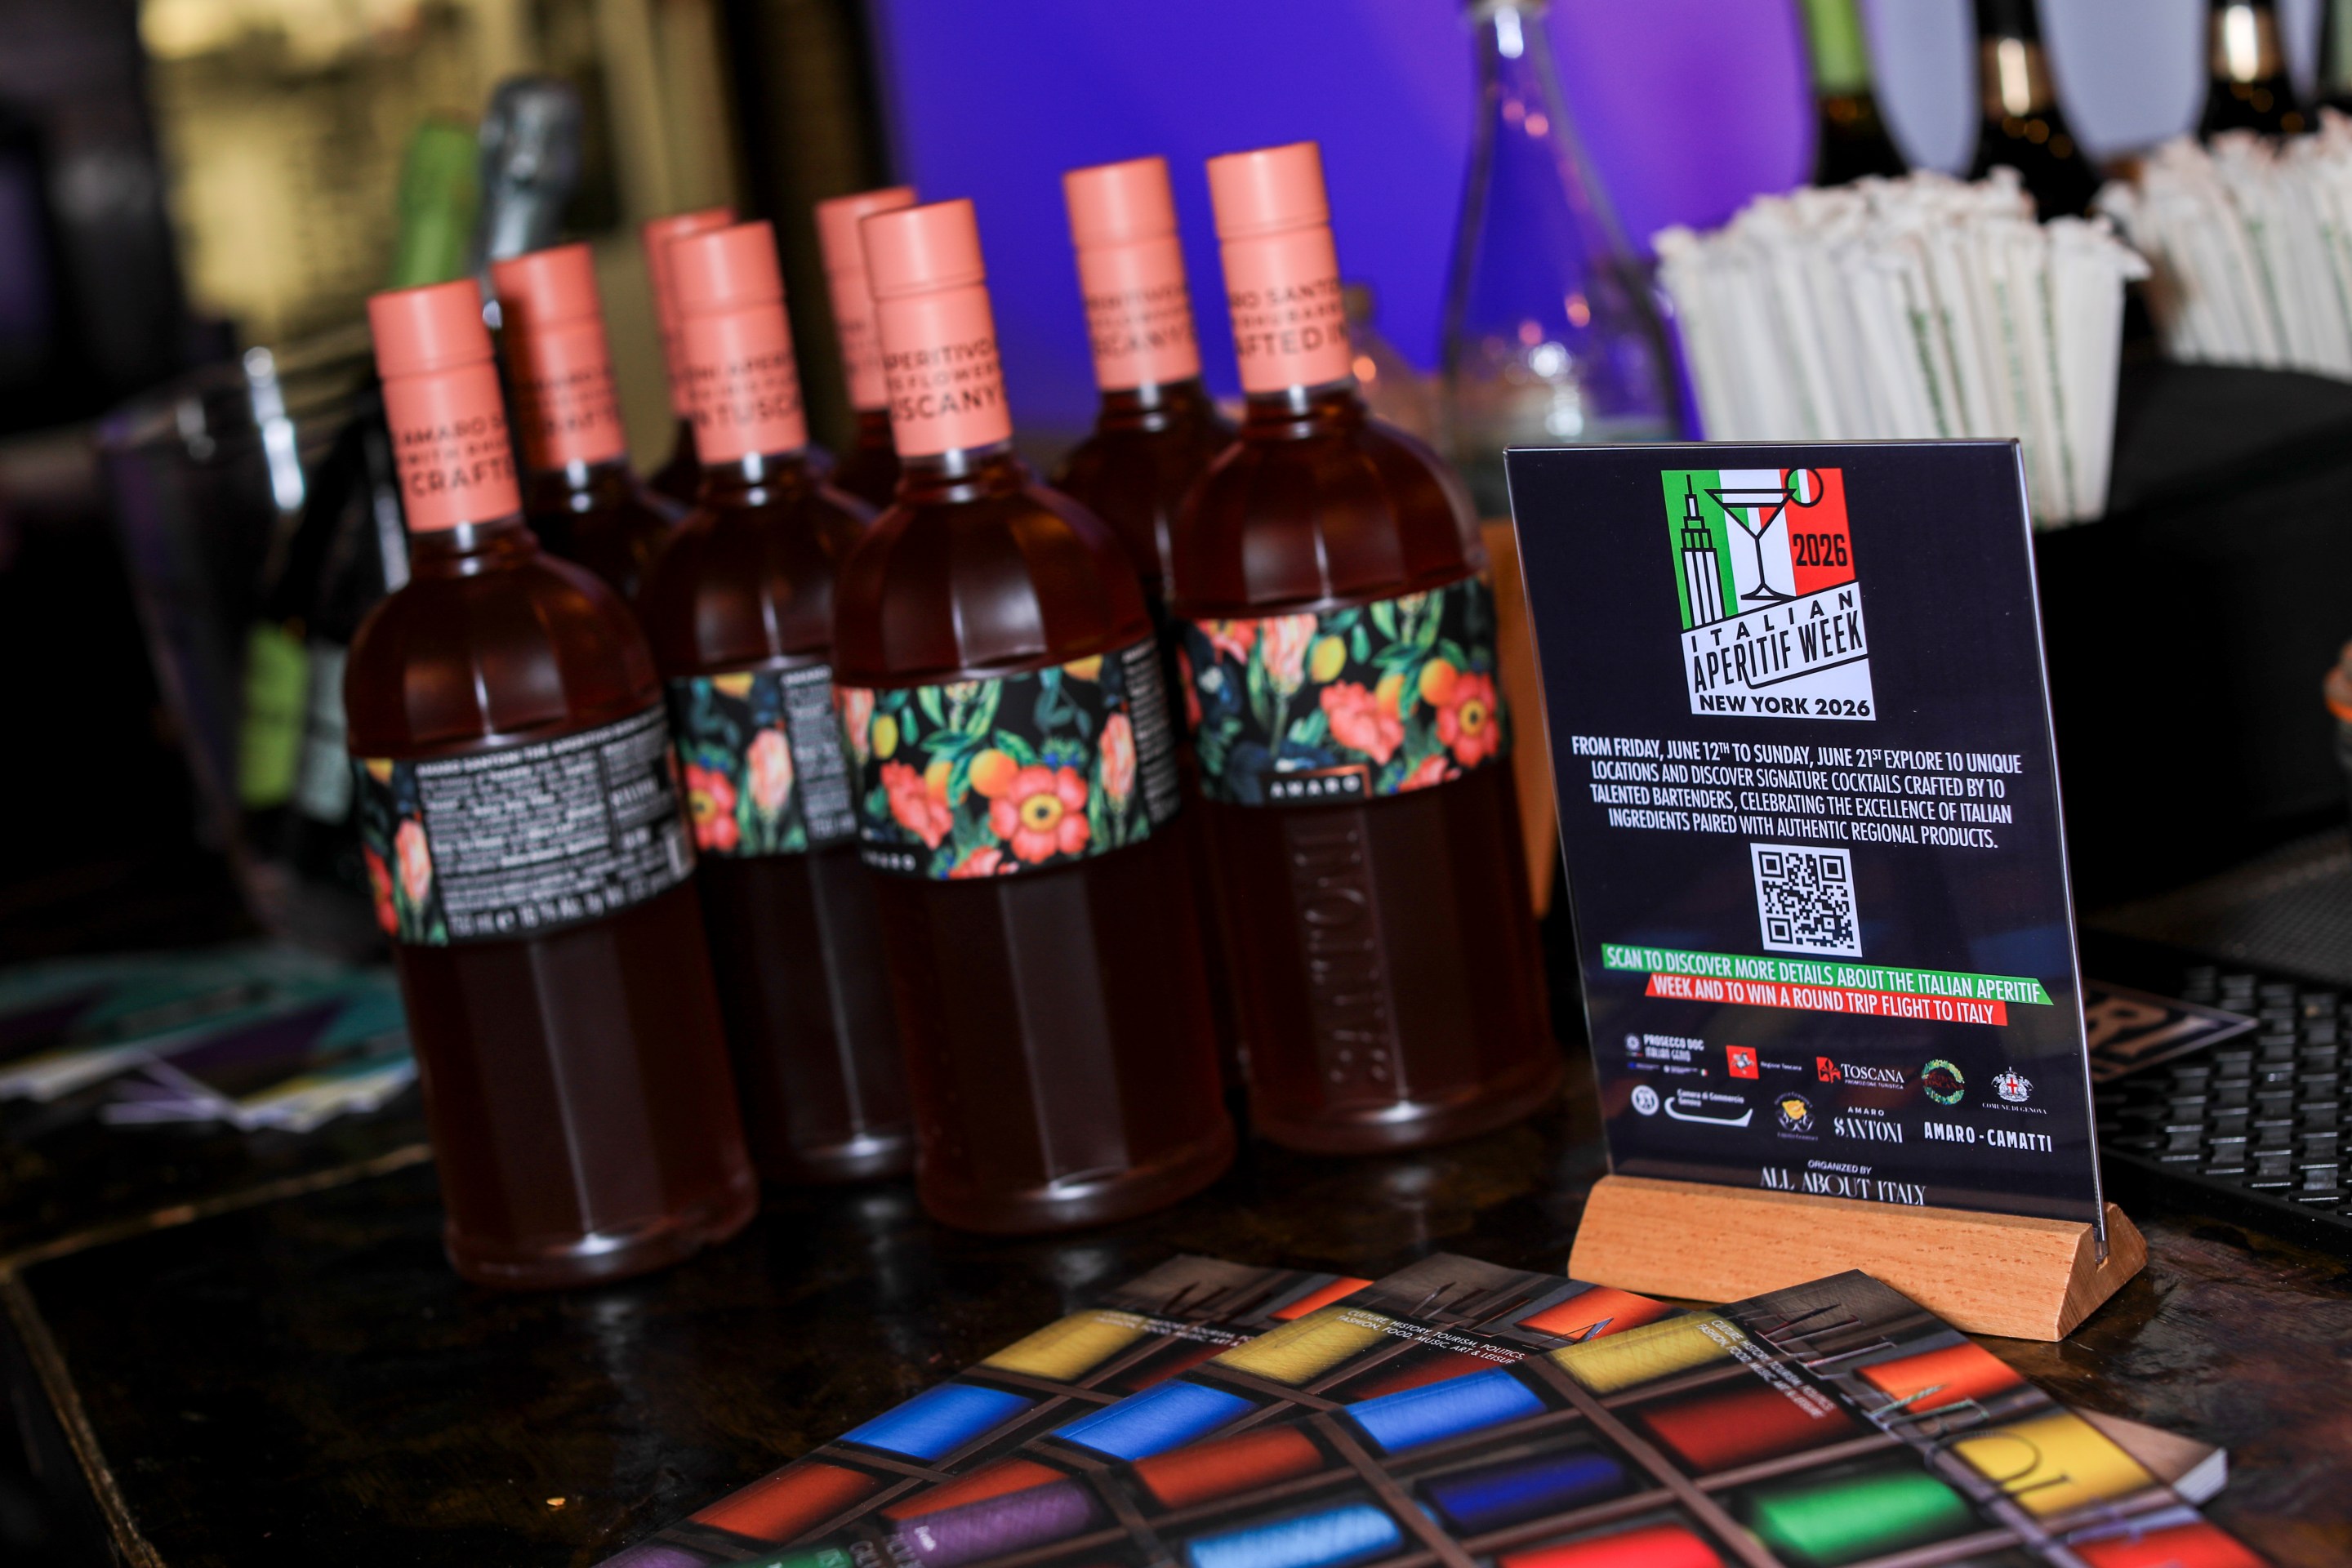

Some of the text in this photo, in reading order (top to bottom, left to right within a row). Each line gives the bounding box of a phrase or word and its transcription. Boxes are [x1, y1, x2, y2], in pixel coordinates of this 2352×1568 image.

[1794, 533, 1847, 567] 2026
[1691, 590, 1853, 654] ITALIAN
[1694, 610, 1864, 693] APERITIF WEEK
[1699, 694, 1870, 717] NEW YORK 2026
[1571, 736, 2023, 774] FROM FRIDAY, JUNE 12TH TO SUNDAY, JUNE 21ST EXPLORE 10 UNIQUE
[1591, 760, 2005, 799] LOCATIONS AND DISCOVER SIGNATURE COCKTAILS CRAFTED BY 10
[1590, 783, 2013, 824] TALENTED BARTENDERS, CELEBRATING THE EXCELLENCE OF ITALIAN
[1608, 808, 1998, 849] INGREDIENTS PAIRED WITH AUTHENTIC REGIONAL PRODUCTS.
[1606, 947, 2041, 1003] SCAN TO DISCOVER MORE DETAILS ABOUT THE ITALIAN APERITIF
[1652, 974, 1993, 1024] WEEK AND TO WIN A ROUND TRIP FLIGHT TO ITALY
[1643, 1034, 1705, 1051] PROSECCO DOC
[1841, 1063, 1904, 1083] TOSCANA
[1848, 1107, 1884, 1116] AMARO
[1982, 1102, 2010, 1111] COMUNE
[2020, 1107, 2047, 1115] GENOVA
[1833, 1116, 1903, 1143] SANTONI
[1924, 1121, 1975, 1143] AMARO
[1987, 1129, 2052, 1152] CAMATTI
[1760, 1166, 1927, 1205] ALL ABOUT ITALY
[1807, 1160, 1872, 1175] ORGANIZED BY
[1337, 1315, 1380, 1331] FASHION,
[1382, 1326, 1413, 1339] FOOD,
[1414, 1335, 1450, 1349] MUSIC,
[1450, 1345, 1472, 1353] ART
[1390, 1321, 1432, 1335] HISTORY,
[1433, 1331, 1478, 1348] TOURISM,
[1480, 1343, 1526, 1360] POLITICS,
